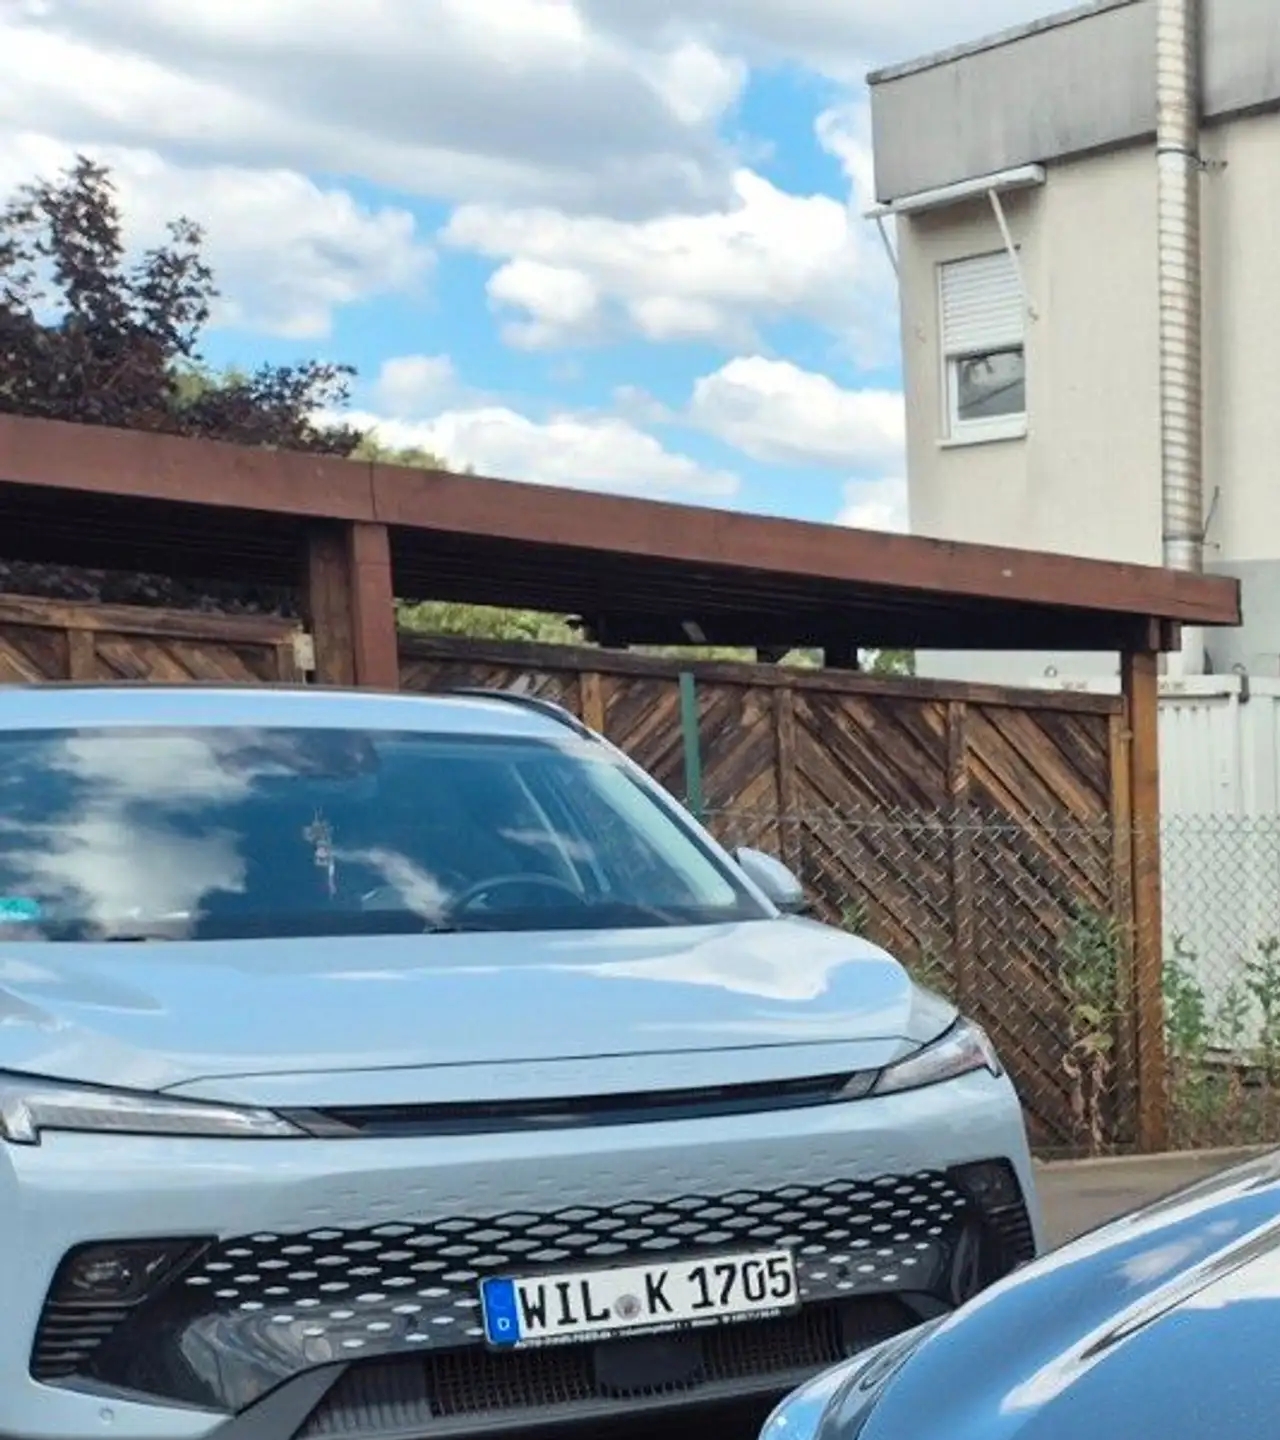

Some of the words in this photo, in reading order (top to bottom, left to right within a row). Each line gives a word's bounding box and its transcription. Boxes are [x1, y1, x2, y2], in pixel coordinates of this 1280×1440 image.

[498, 1318, 511, 1331] D
[518, 1280, 611, 1330] WIL
[645, 1271, 673, 1314] K
[689, 1258, 792, 1310] 1705
